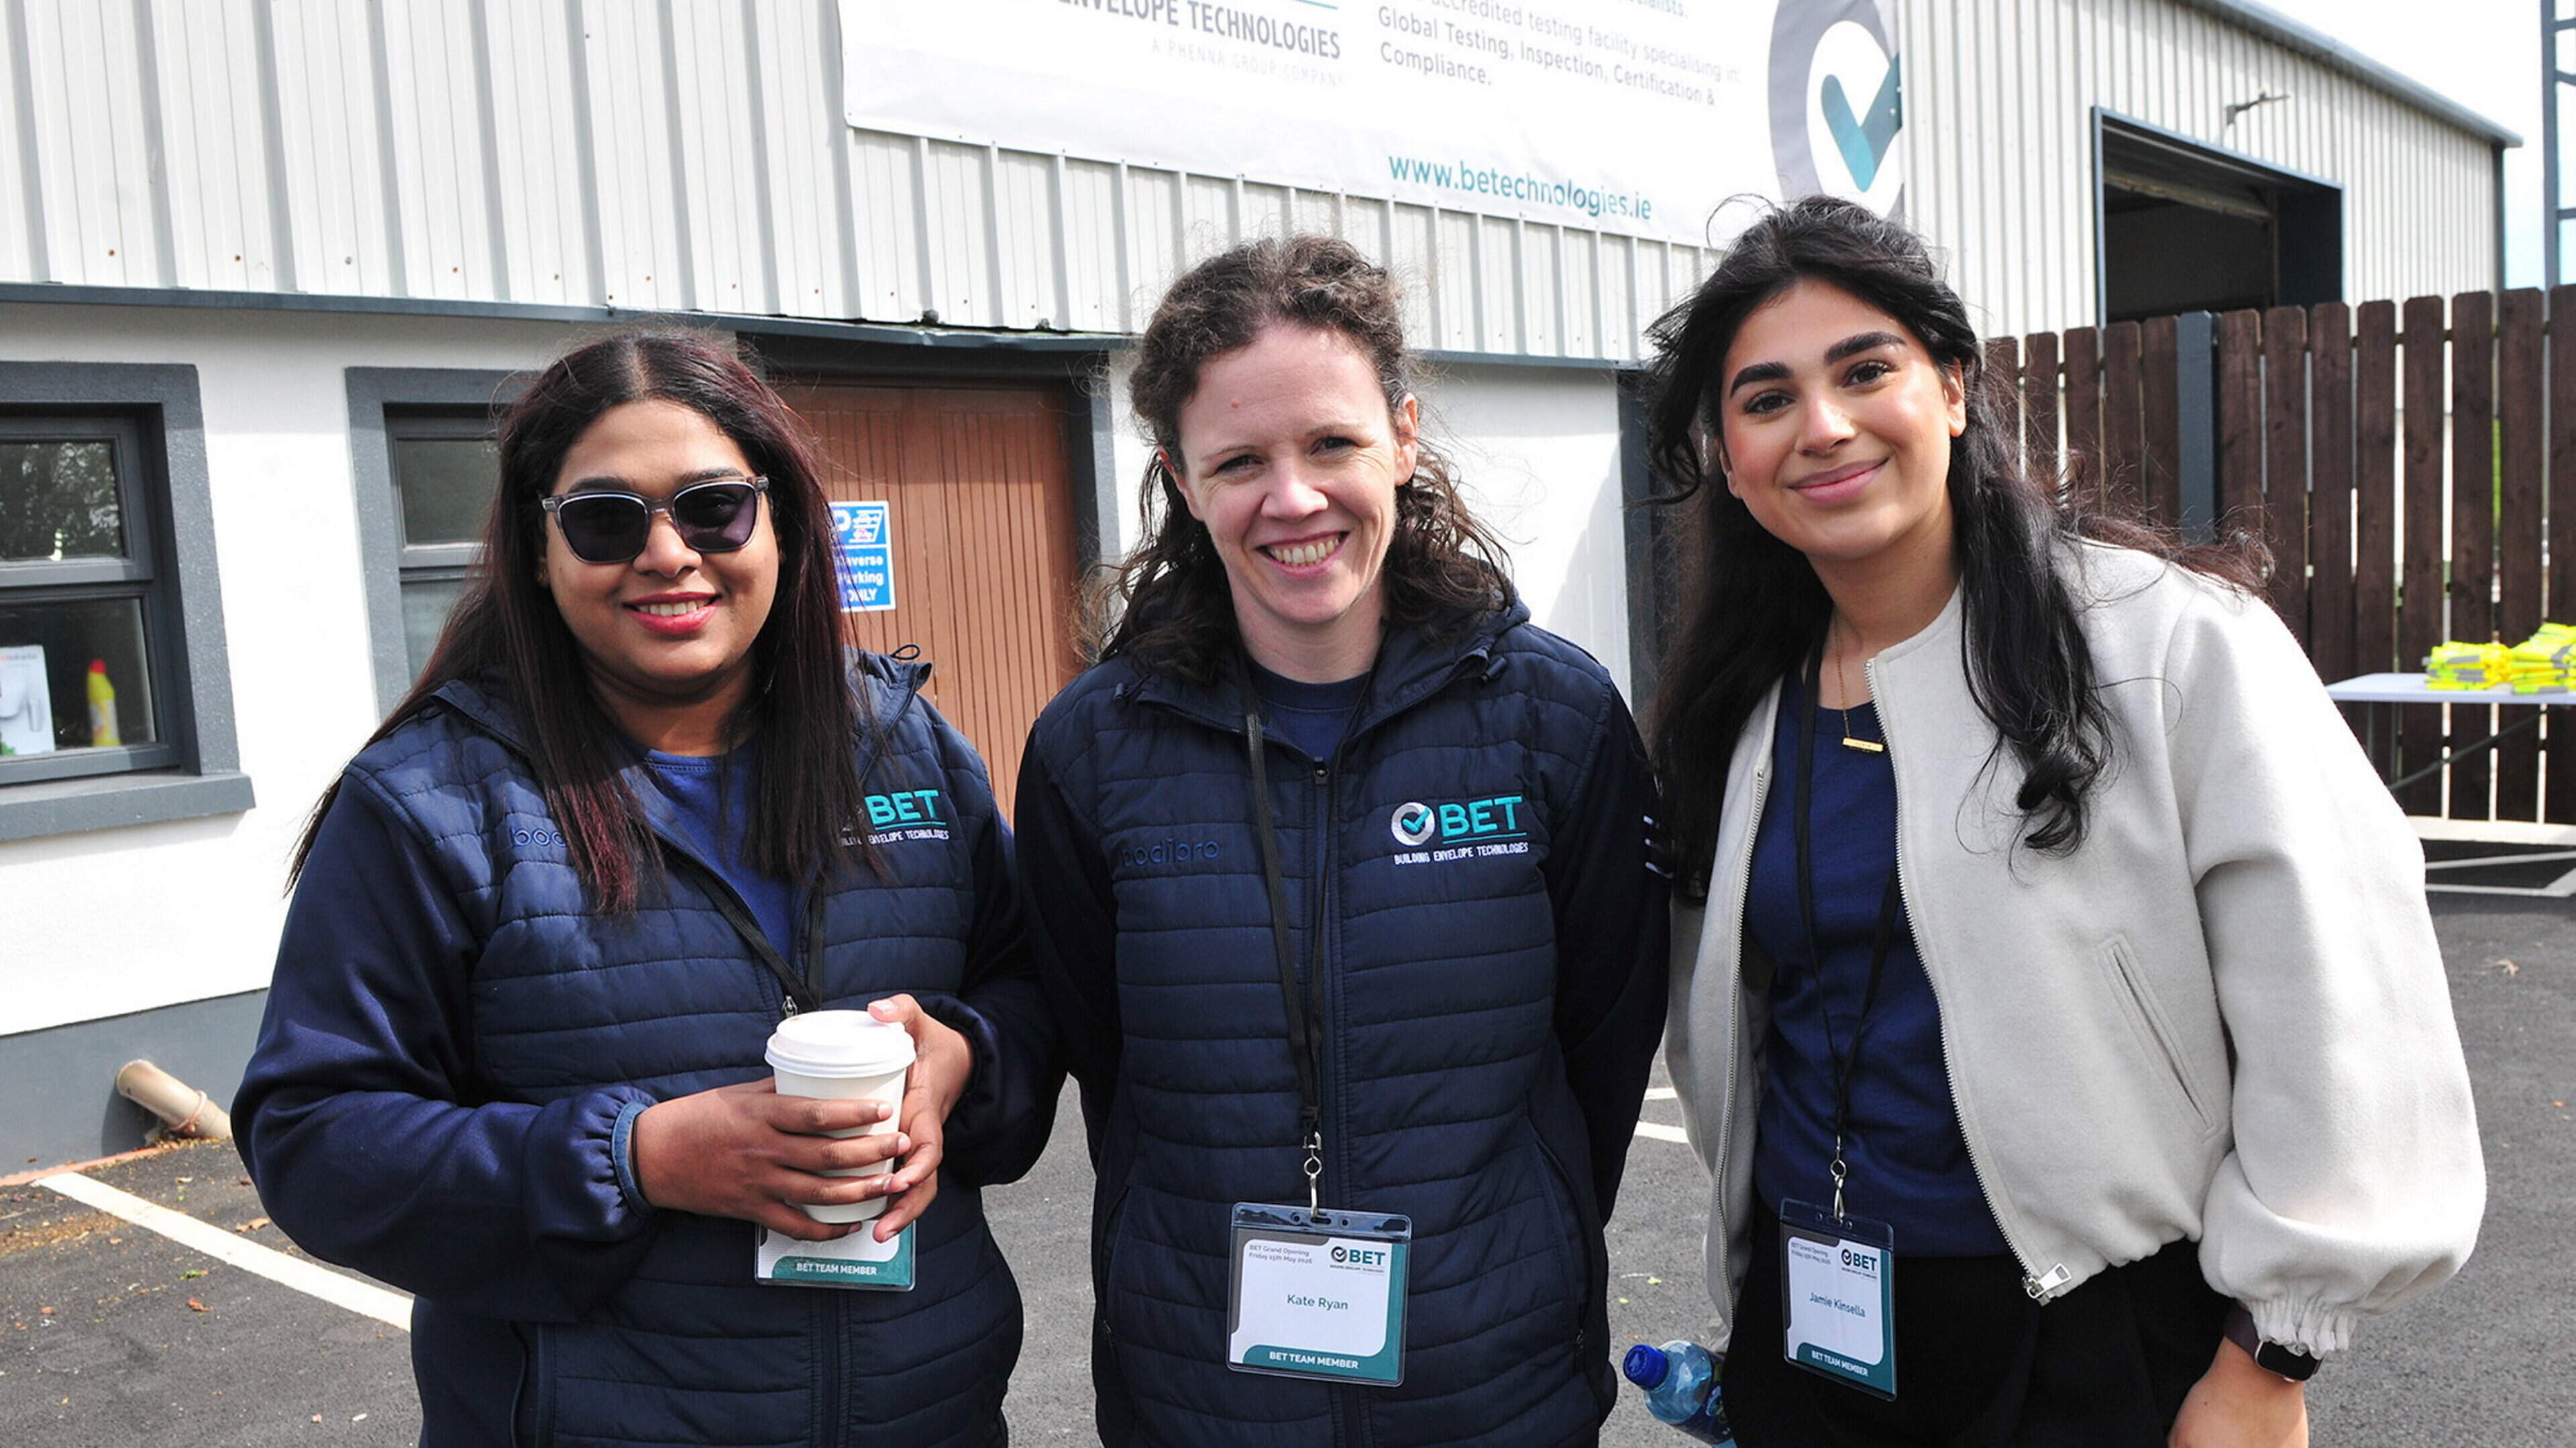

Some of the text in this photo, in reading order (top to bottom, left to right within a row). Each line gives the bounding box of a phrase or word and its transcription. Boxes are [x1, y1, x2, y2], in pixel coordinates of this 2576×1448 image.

[1057, 0, 1341, 59] LOPE TECHNOLOGIES
[1378, 5, 1715, 106] Global Testing, Inspection, Certification &
[1529, 11, 1582, 46] testing
[1589, 25, 1638, 60] facility
[1644, 44, 1722, 82] specialising
[1380, 41, 1492, 86] Compliance.
[1389, 155, 1652, 220] www.betechnologies.ie
[864, 789, 939, 825] BET
[1439, 796, 1523, 837] BET
[1394, 842, 1529, 865] BUILDING ENVELOPE TECHNOLOGIES
[796, 1262, 877, 1276] BET TEAM MEMBER
[1349, 1249, 1386, 1266] BET
[1853, 1252, 1877, 1271] BET
[1287, 1294, 1348, 1311] Kate Ryan
[1269, 1351, 1359, 1370] BET TEAM MEMBER
[1812, 1349, 1868, 1378] BET TEAM MEMBER
